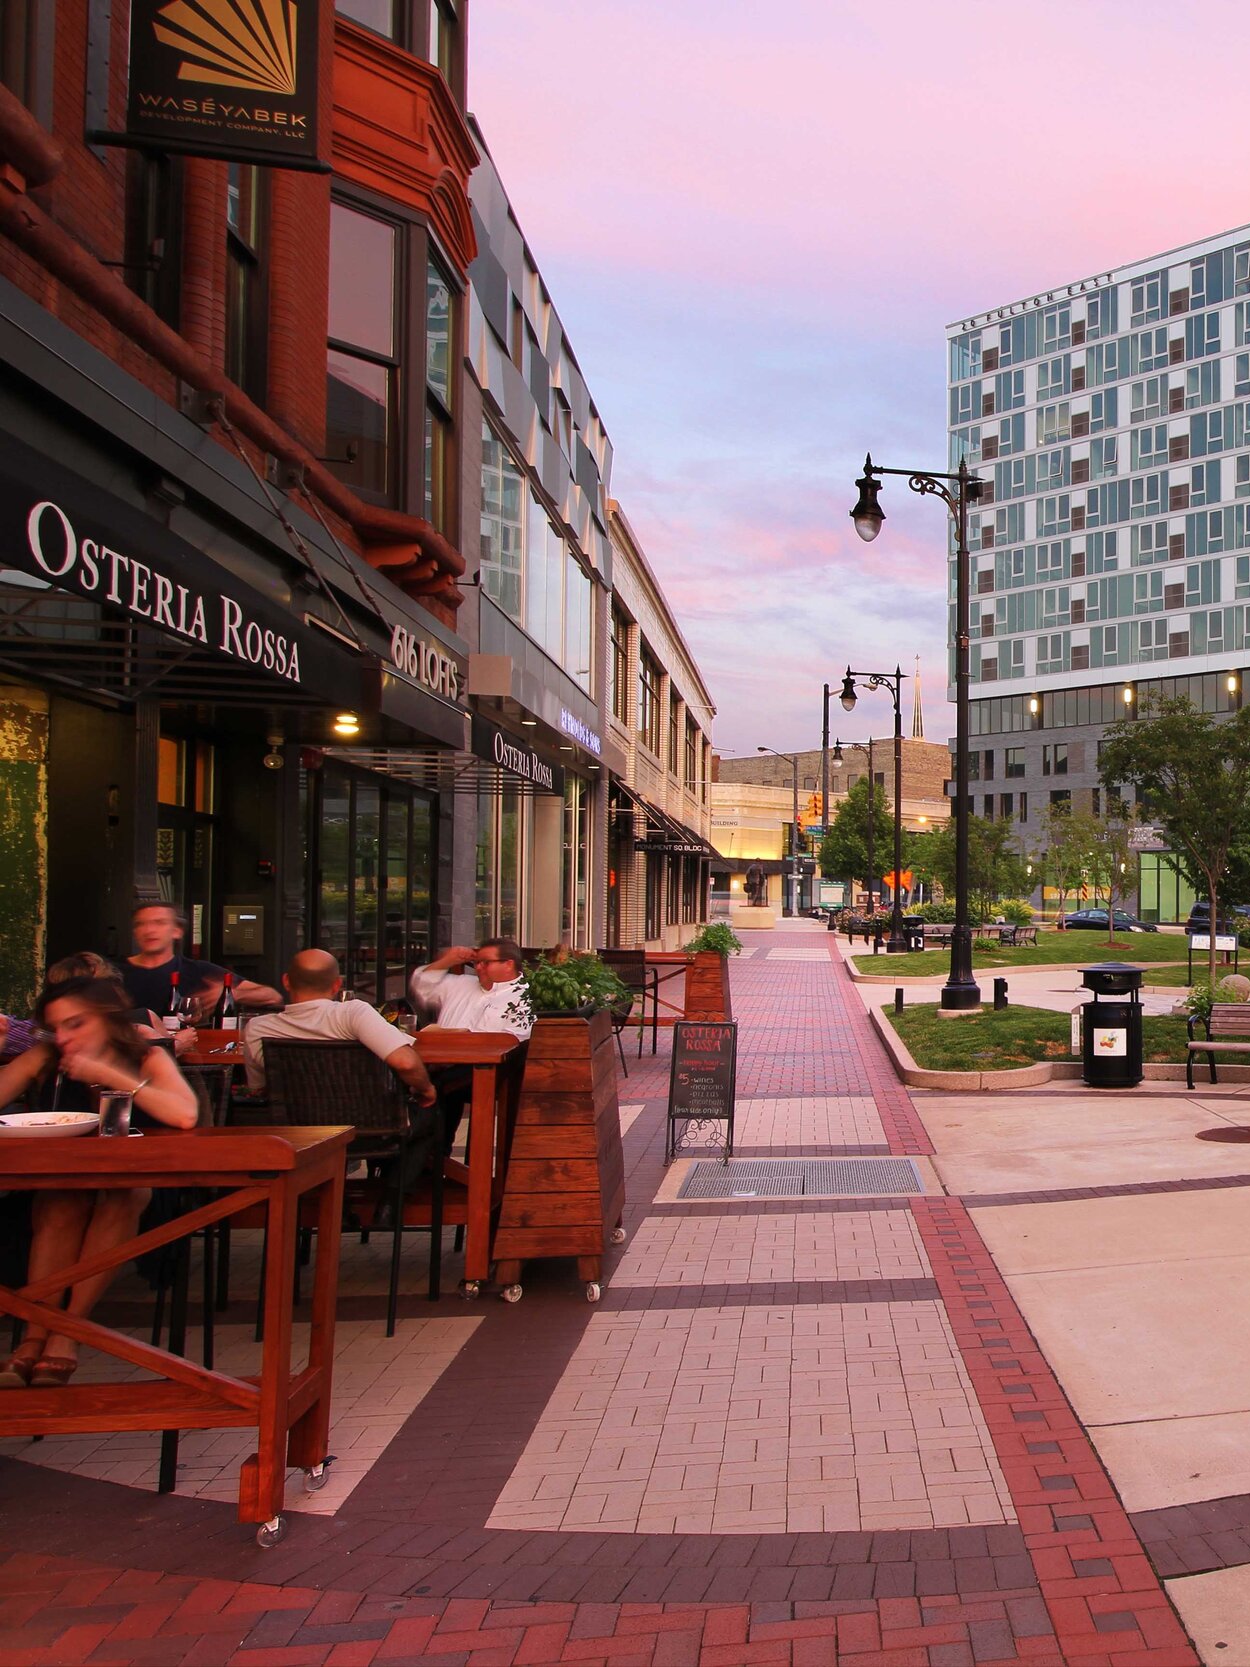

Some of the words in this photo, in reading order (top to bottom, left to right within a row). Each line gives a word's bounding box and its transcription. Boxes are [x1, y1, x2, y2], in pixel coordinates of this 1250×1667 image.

[139, 92, 307, 128] WASÉYABEK
[139, 110, 223, 128] DEVELOPMENT
[285, 130, 305, 139] LLC
[27, 501, 208, 644] OSTERIA
[219, 594, 301, 683] ROSSA
[391, 624, 418, 678] 616
[419, 640, 459, 701] LOFTS
[494, 731, 530, 779] OSTERIA
[531, 752, 553, 790] ROSSA
[682, 1027, 731, 1040] OSTERIA
[685, 1039, 721, 1052] ROSSA
